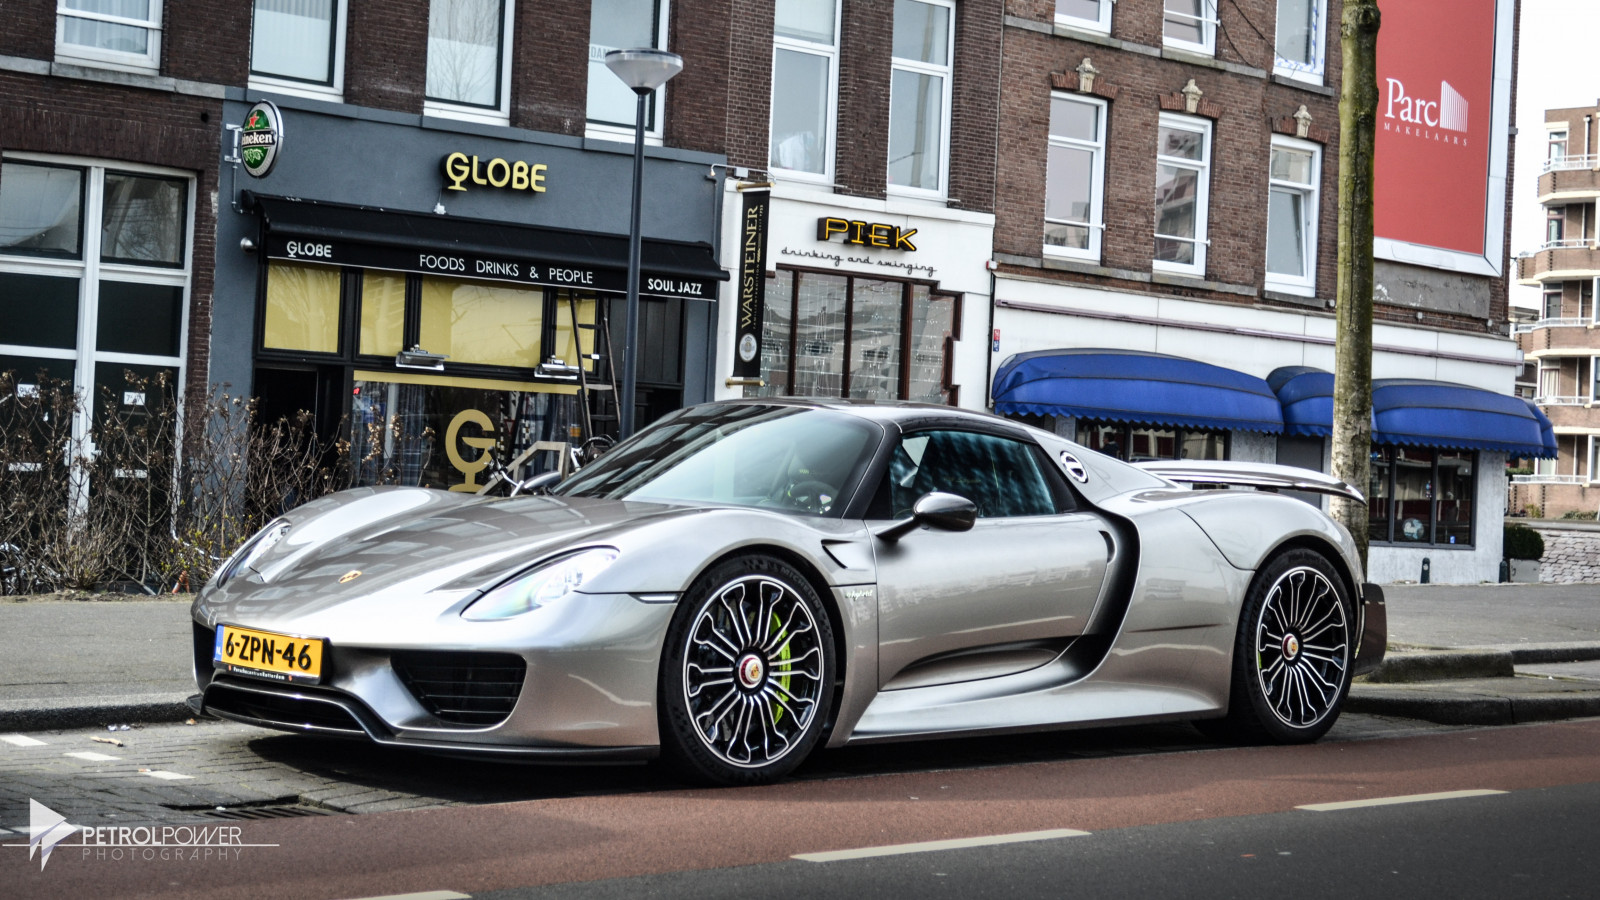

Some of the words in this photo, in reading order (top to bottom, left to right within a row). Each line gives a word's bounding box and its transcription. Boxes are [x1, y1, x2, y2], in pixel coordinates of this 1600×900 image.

[1384, 77, 1438, 127] Parc
[1384, 122, 1467, 146] MAKELAARS
[445, 151, 548, 193] GLOBE
[286, 240, 332, 258] GLOBE
[822, 217, 918, 251] PIEK
[419, 254, 465, 272] FOODS
[476, 260, 519, 277] DRINKS
[529, 266, 539, 279] &
[549, 267, 593, 284] PEOPLE
[741, 206, 758, 329] WARSTEINER
[781, 246, 843, 267] drinking
[847, 256, 873, 265] and
[877, 259, 937, 278] swinging
[647, 278, 675, 292] SOUL
[677, 281, 702, 295] JAZZ
[225, 632, 312, 670] 6-ZPN-46
